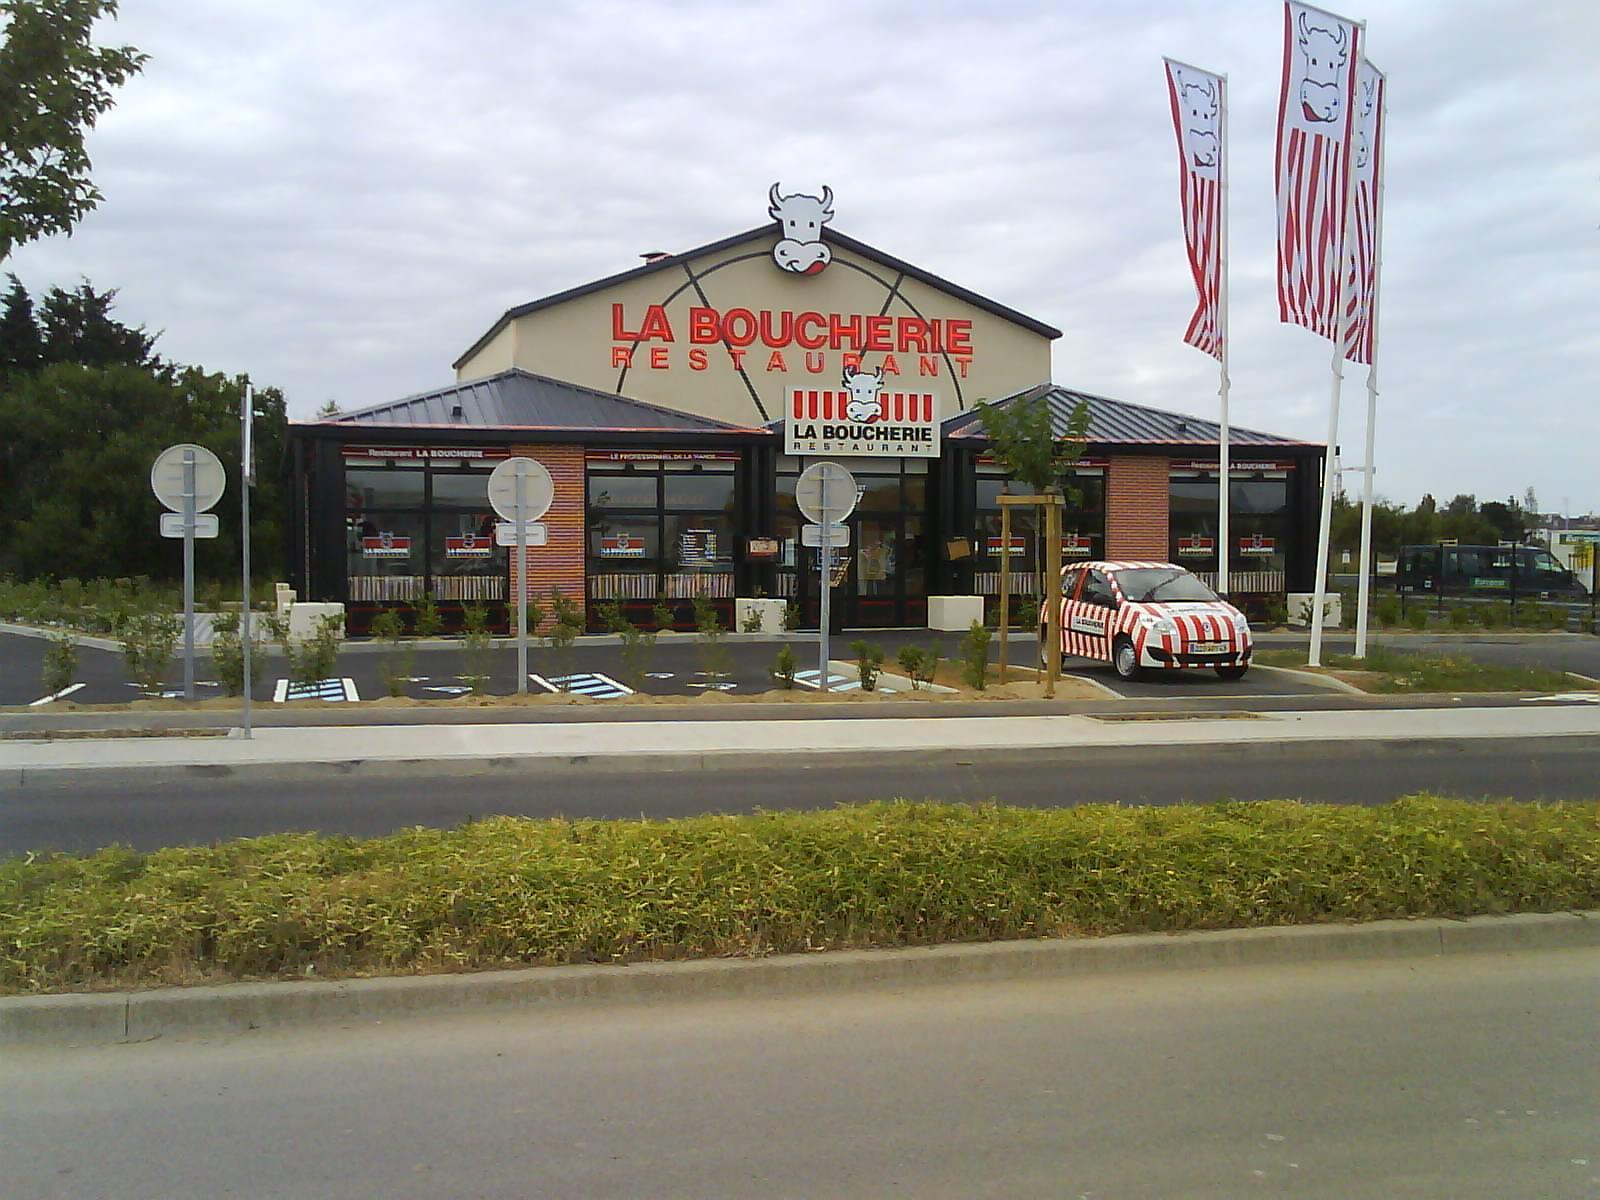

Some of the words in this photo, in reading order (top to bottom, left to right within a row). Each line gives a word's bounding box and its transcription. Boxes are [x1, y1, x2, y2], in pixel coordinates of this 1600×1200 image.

[612, 303, 675, 343] LA
[689, 307, 974, 355] BOUCHERIE
[611, 346, 973, 378] RESTAURANT
[794, 424, 817, 440] LA
[822, 424, 932, 442] BOUCHERIE
[793, 441, 933, 453] RESTAURANT
